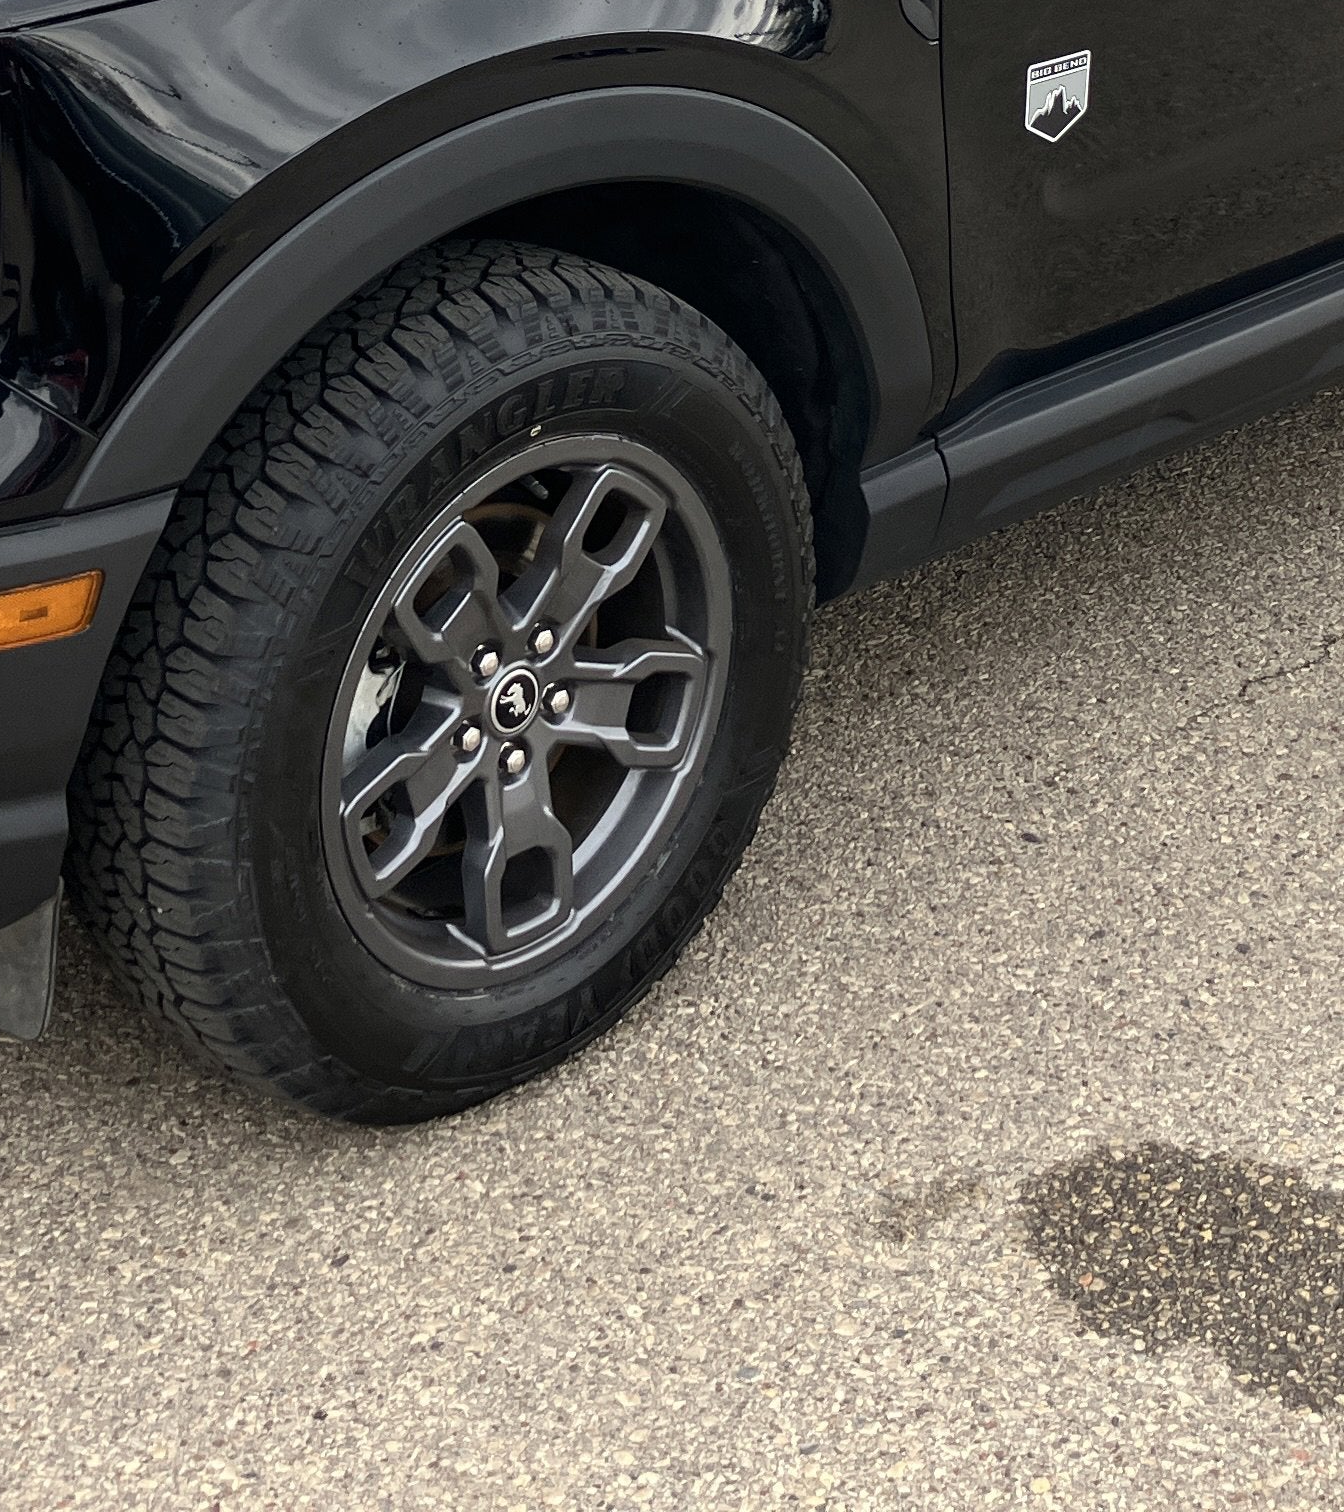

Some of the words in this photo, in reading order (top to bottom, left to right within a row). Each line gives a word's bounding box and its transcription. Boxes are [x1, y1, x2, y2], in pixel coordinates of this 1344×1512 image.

[1031, 67, 1052, 80] BIG
[1054, 57, 1087, 73] BEND
[345, 367, 629, 583] WRANGLER
